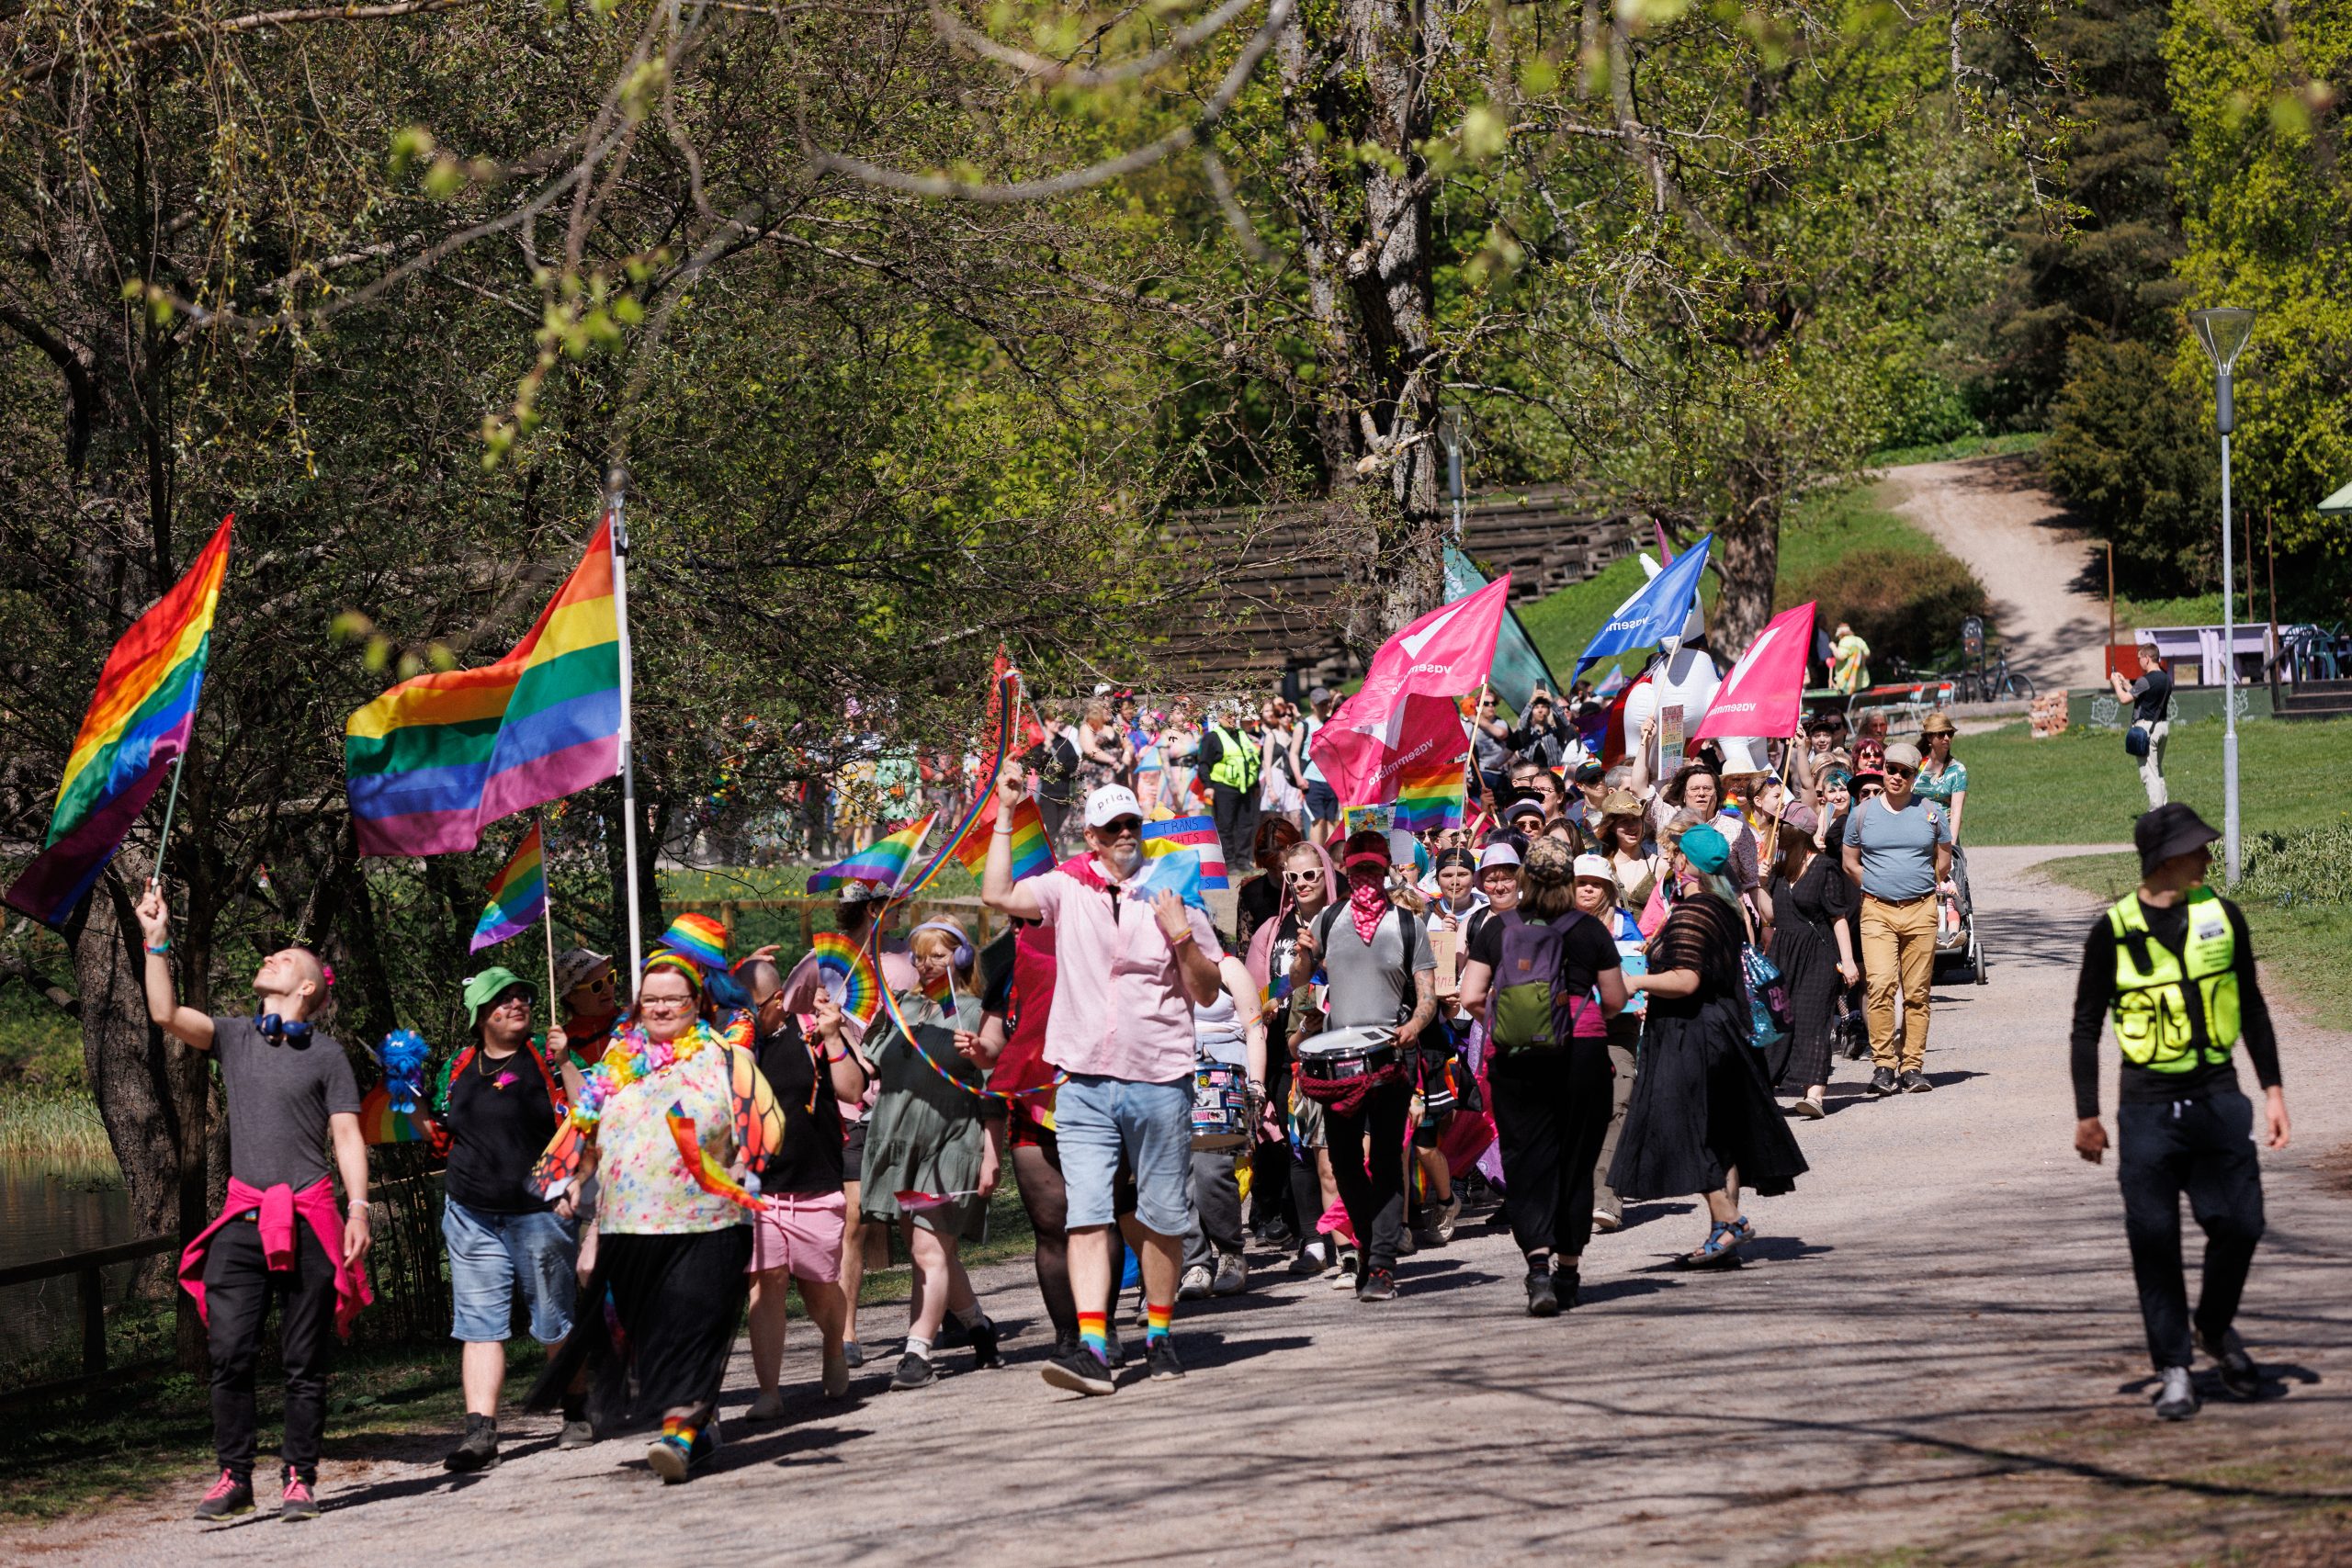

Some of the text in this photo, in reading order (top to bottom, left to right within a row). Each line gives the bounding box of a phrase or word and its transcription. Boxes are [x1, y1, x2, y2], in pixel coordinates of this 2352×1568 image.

[1097, 794, 1131, 811] pride
[1160, 818, 1199, 834] TRANS
[1165, 832, 1199, 844] GHTS
